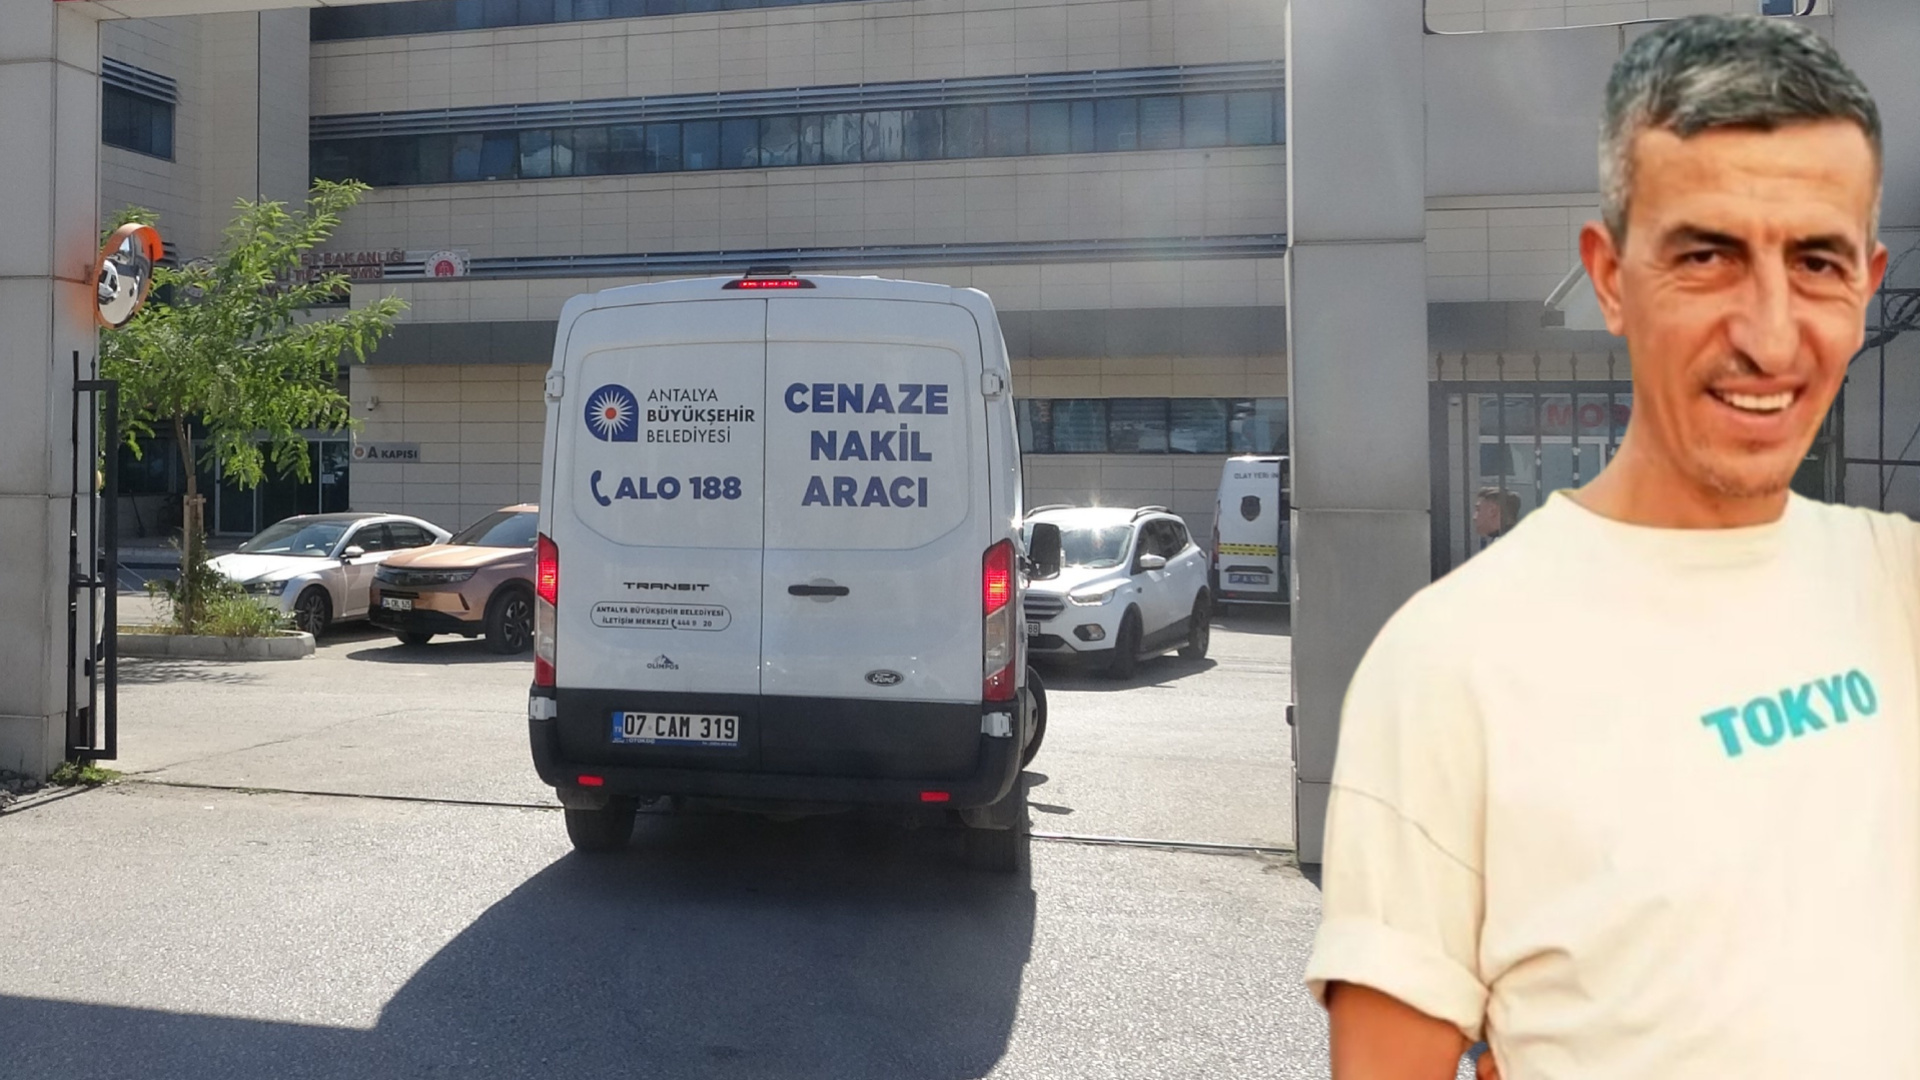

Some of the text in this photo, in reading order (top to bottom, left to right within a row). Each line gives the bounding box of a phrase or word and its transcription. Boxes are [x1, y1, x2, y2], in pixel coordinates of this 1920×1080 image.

[647, 388, 718, 402] ANTALYA
[784, 382, 949, 415] CENAZE
[646, 405, 755, 426] BÜYÜKŞEHİR
[647, 426, 731, 443] BELEDİYESİ
[810, 422, 933, 462] NAKİL
[367, 446, 418, 460] A KAPISI
[614, 476, 742, 500] ALO 188
[801, 476, 928, 508] ARACI
[623, 582, 710, 591] TRANSIT
[596, 606, 724, 617] ANTALYA BÜYÜKŞEHİR BELEDİYESİ
[602, 615, 634, 625] İLETİŞİM
[635, 617, 669, 626] MERKEZİ
[872, 673, 897, 683] Ford
[1700, 668, 1877, 757] TOKYO
[624, 714, 647, 736] 07
[655, 715, 691, 738] CAM
[700, 717, 736, 740] 319
